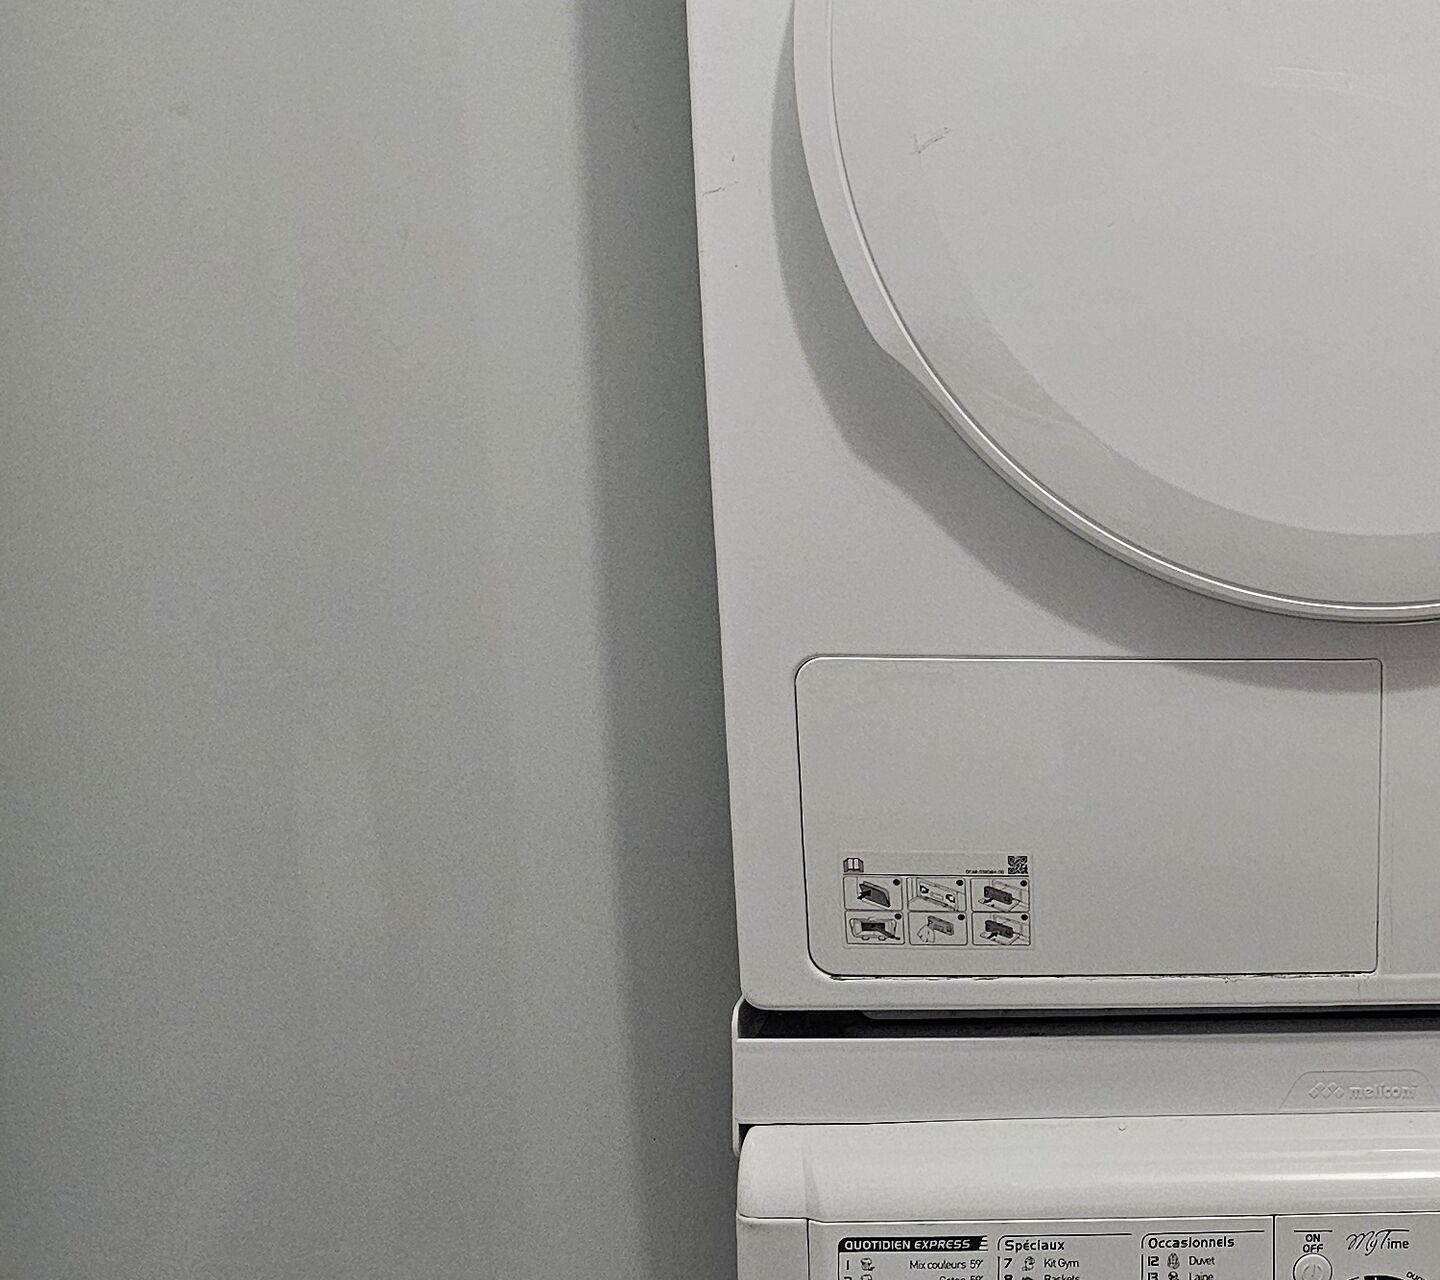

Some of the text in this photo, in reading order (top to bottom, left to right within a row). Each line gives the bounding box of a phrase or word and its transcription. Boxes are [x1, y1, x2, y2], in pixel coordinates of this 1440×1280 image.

[1148, 1236, 1235, 1249] Occasionnels
[1306, 1233, 1320, 1242] ON
[844, 1239, 970, 1250] QUOTIDIEN EXPRESS
[1004, 1239, 1065, 1253] Spéciaux
[1303, 1244, 1323, 1252] OFF
[846, 1259, 966, 1270] 1 Mix couleurs
[1004, 1258, 1079, 1270] 7 Kit Gym
[1147, 1255, 1215, 1266] 12 Duvet
